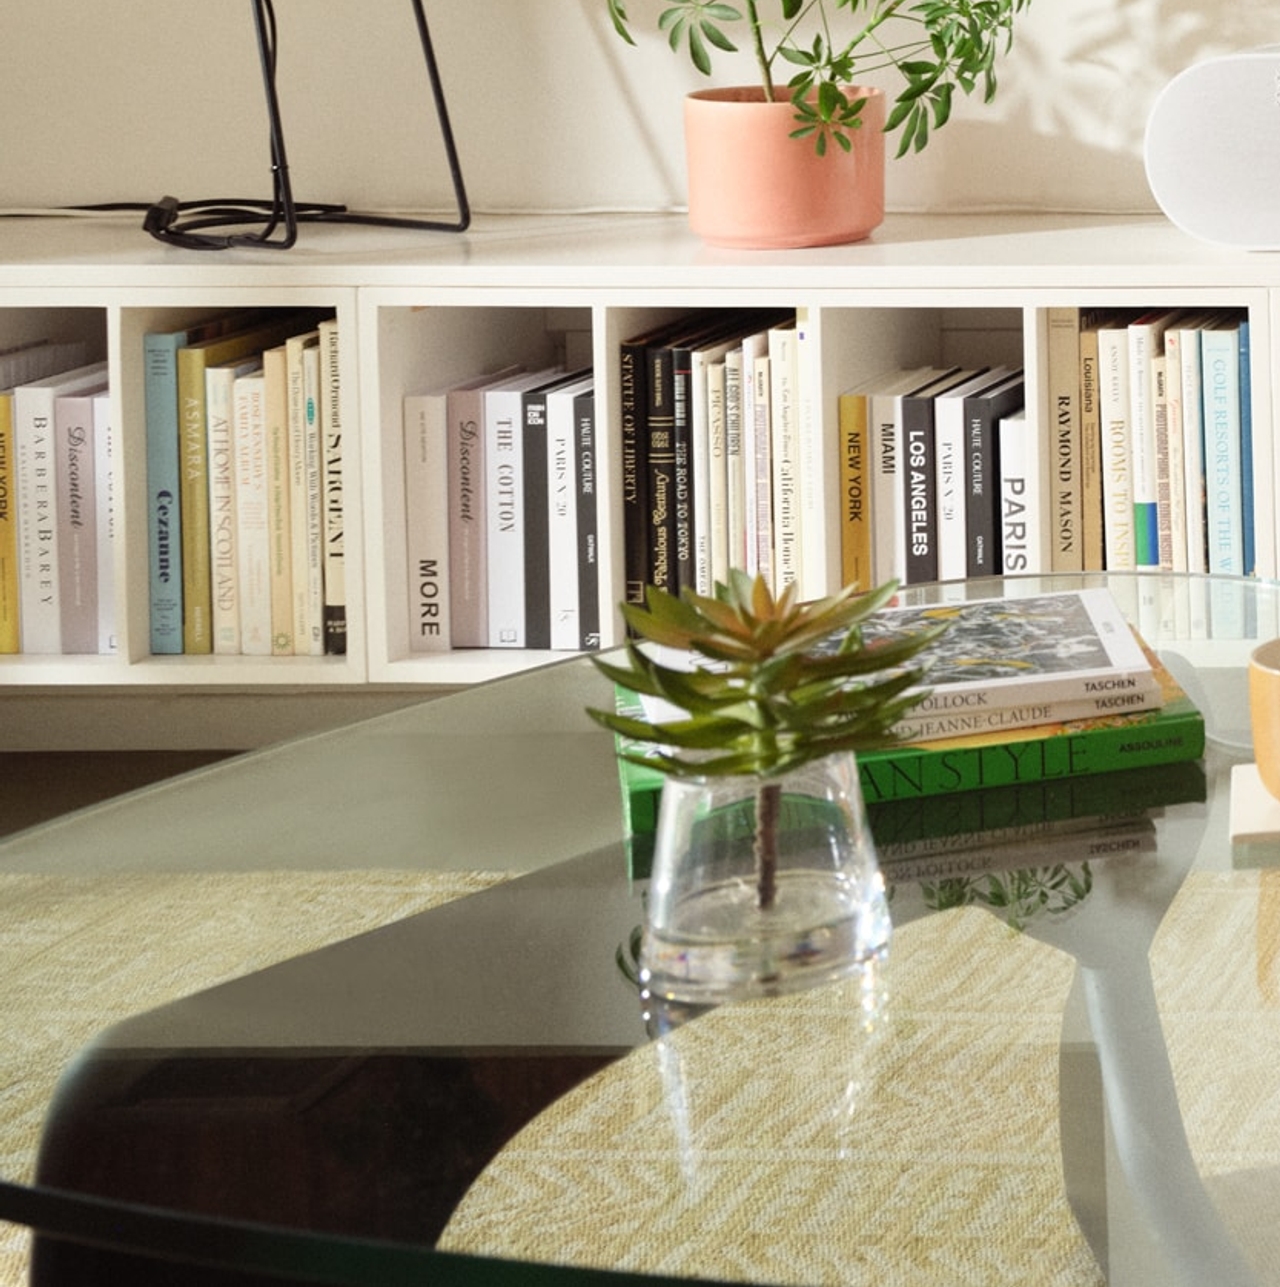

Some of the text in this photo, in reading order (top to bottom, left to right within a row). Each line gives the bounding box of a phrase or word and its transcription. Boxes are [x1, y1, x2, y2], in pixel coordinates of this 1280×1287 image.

[330, 378, 342, 429] Ormond
[1083, 357, 1095, 414] Louisiana
[184, 396, 202, 482] ASMARA
[555, 438, 567, 480] PARIS
[581, 417, 594, 495] HAUTE COUTURE
[622, 354, 638, 504] STATUE OF LIBERTY
[711, 389, 723, 459] PICASSO
[881, 422, 896, 475] MIAMI
[971, 418, 983, 496] HAUTE COUTURE
[1110, 420, 1127, 484] ROOMS
[1212, 358, 1232, 550] GOLF RESORTS OF THE
[69, 425, 87, 530] Discontent
[213, 439, 231, 491] HOME
[307, 470, 318, 492] With
[459, 420, 479, 524] Discontent
[496, 417, 517, 533] THE COTTON
[780, 458, 795, 529] California
[848, 431, 863, 523] NEW YORK
[909, 430, 929, 557] LOS ANGELES
[941, 442, 953, 485] PARIS
[1058, 395, 1074, 553] RAYMOND MASON
[156, 489, 174, 584] Cezanne
[214, 495, 231, 511] IN
[308, 493, 319, 521] Words
[652, 468, 670, 586] Fabulous Century
[675, 441, 690, 561] THE ROAD TO TOKYO
[1003, 477, 1028, 572] PARIS
[1112, 490, 1128, 514] TO
[216, 515, 234, 611] SCOTLAND
[419, 559, 440, 637] MORE
[911, 692, 987, 713] POLLOCK
[1083, 679, 1137, 694] TASCHEN
[1095, 695, 1146, 711] TASCHEN
[939, 735, 1090, 791] STYLE
[1118, 737, 1185, 754] ASSOULINE
